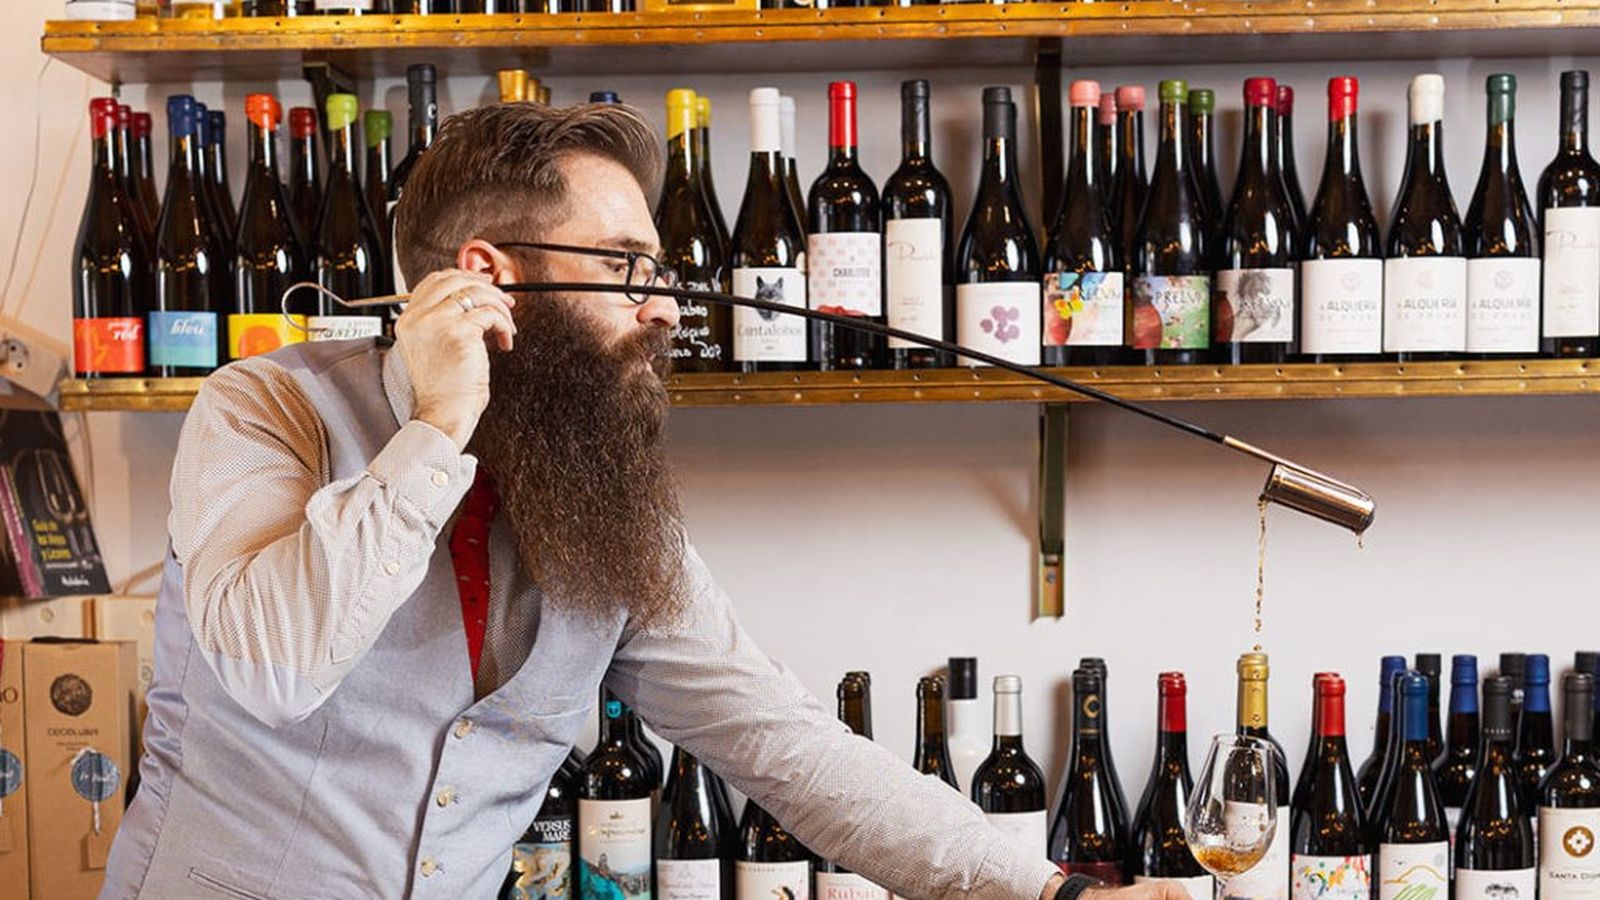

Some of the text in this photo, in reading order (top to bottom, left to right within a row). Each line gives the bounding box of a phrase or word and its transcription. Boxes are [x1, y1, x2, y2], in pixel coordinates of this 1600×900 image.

[533, 818, 572, 833] VERSUS
[542, 829, 572, 842] MARE
[1549, 871, 1577, 881] SANTA
